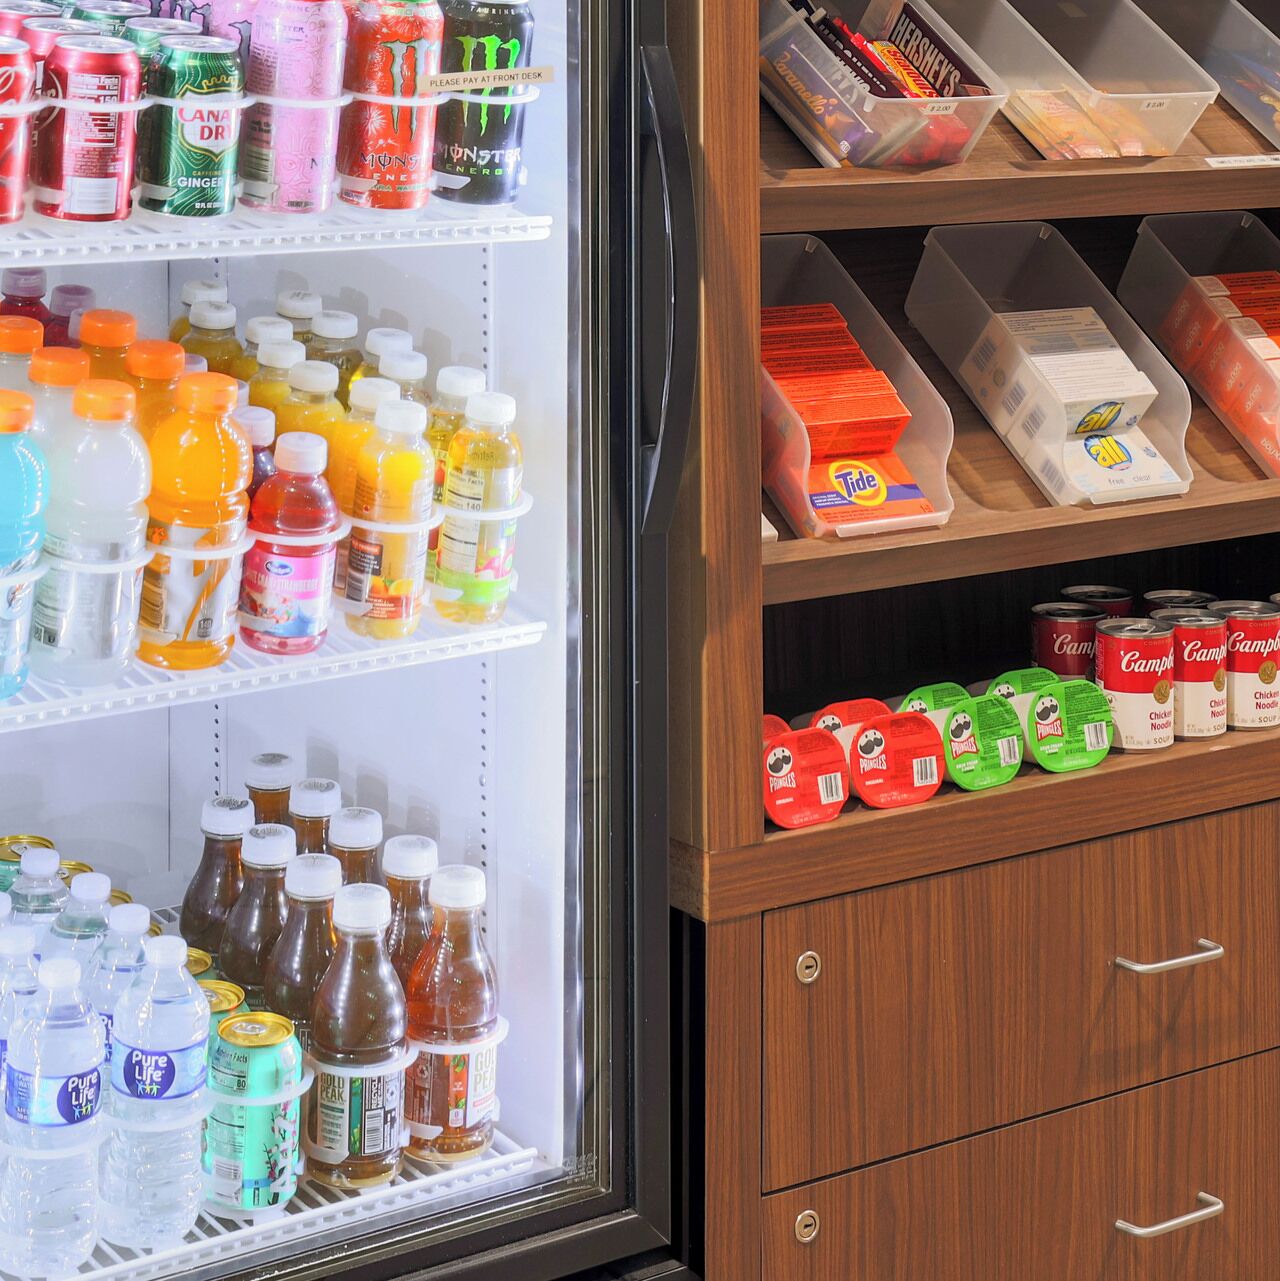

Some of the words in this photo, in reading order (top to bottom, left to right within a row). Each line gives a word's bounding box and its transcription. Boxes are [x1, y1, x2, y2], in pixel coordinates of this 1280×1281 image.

[890, 13, 962, 98] HERSHEY'S
[430, 77, 461, 88] PLEASE
[463, 76, 479, 86] PAY
[481, 75, 491, 85] AT
[493, 73, 520, 84] FRONT
[522, 72, 543, 81] DESK
[1075, 402, 1124, 433] all
[1089, 434, 1130, 468] all
[834, 469, 879, 500] Tide
[466, 502, 481, 512] 140
[1255, 700, 1279, 710] Noodle
[1036, 720, 1063, 740] PRINGLES
[951, 736, 978, 757] PRINGLES
[859, 754, 887, 775] PRINGLES
[769, 772, 796, 793] PRINGLES
[132, 1049, 168, 1069] Pure
[68, 1071, 98, 1092] Pure
[135, 1065, 163, 1085] Life
[236, 1078, 247, 1089] 80
[71, 1085, 95, 1107] Life
[320, 1085, 344, 1102] PEAK
